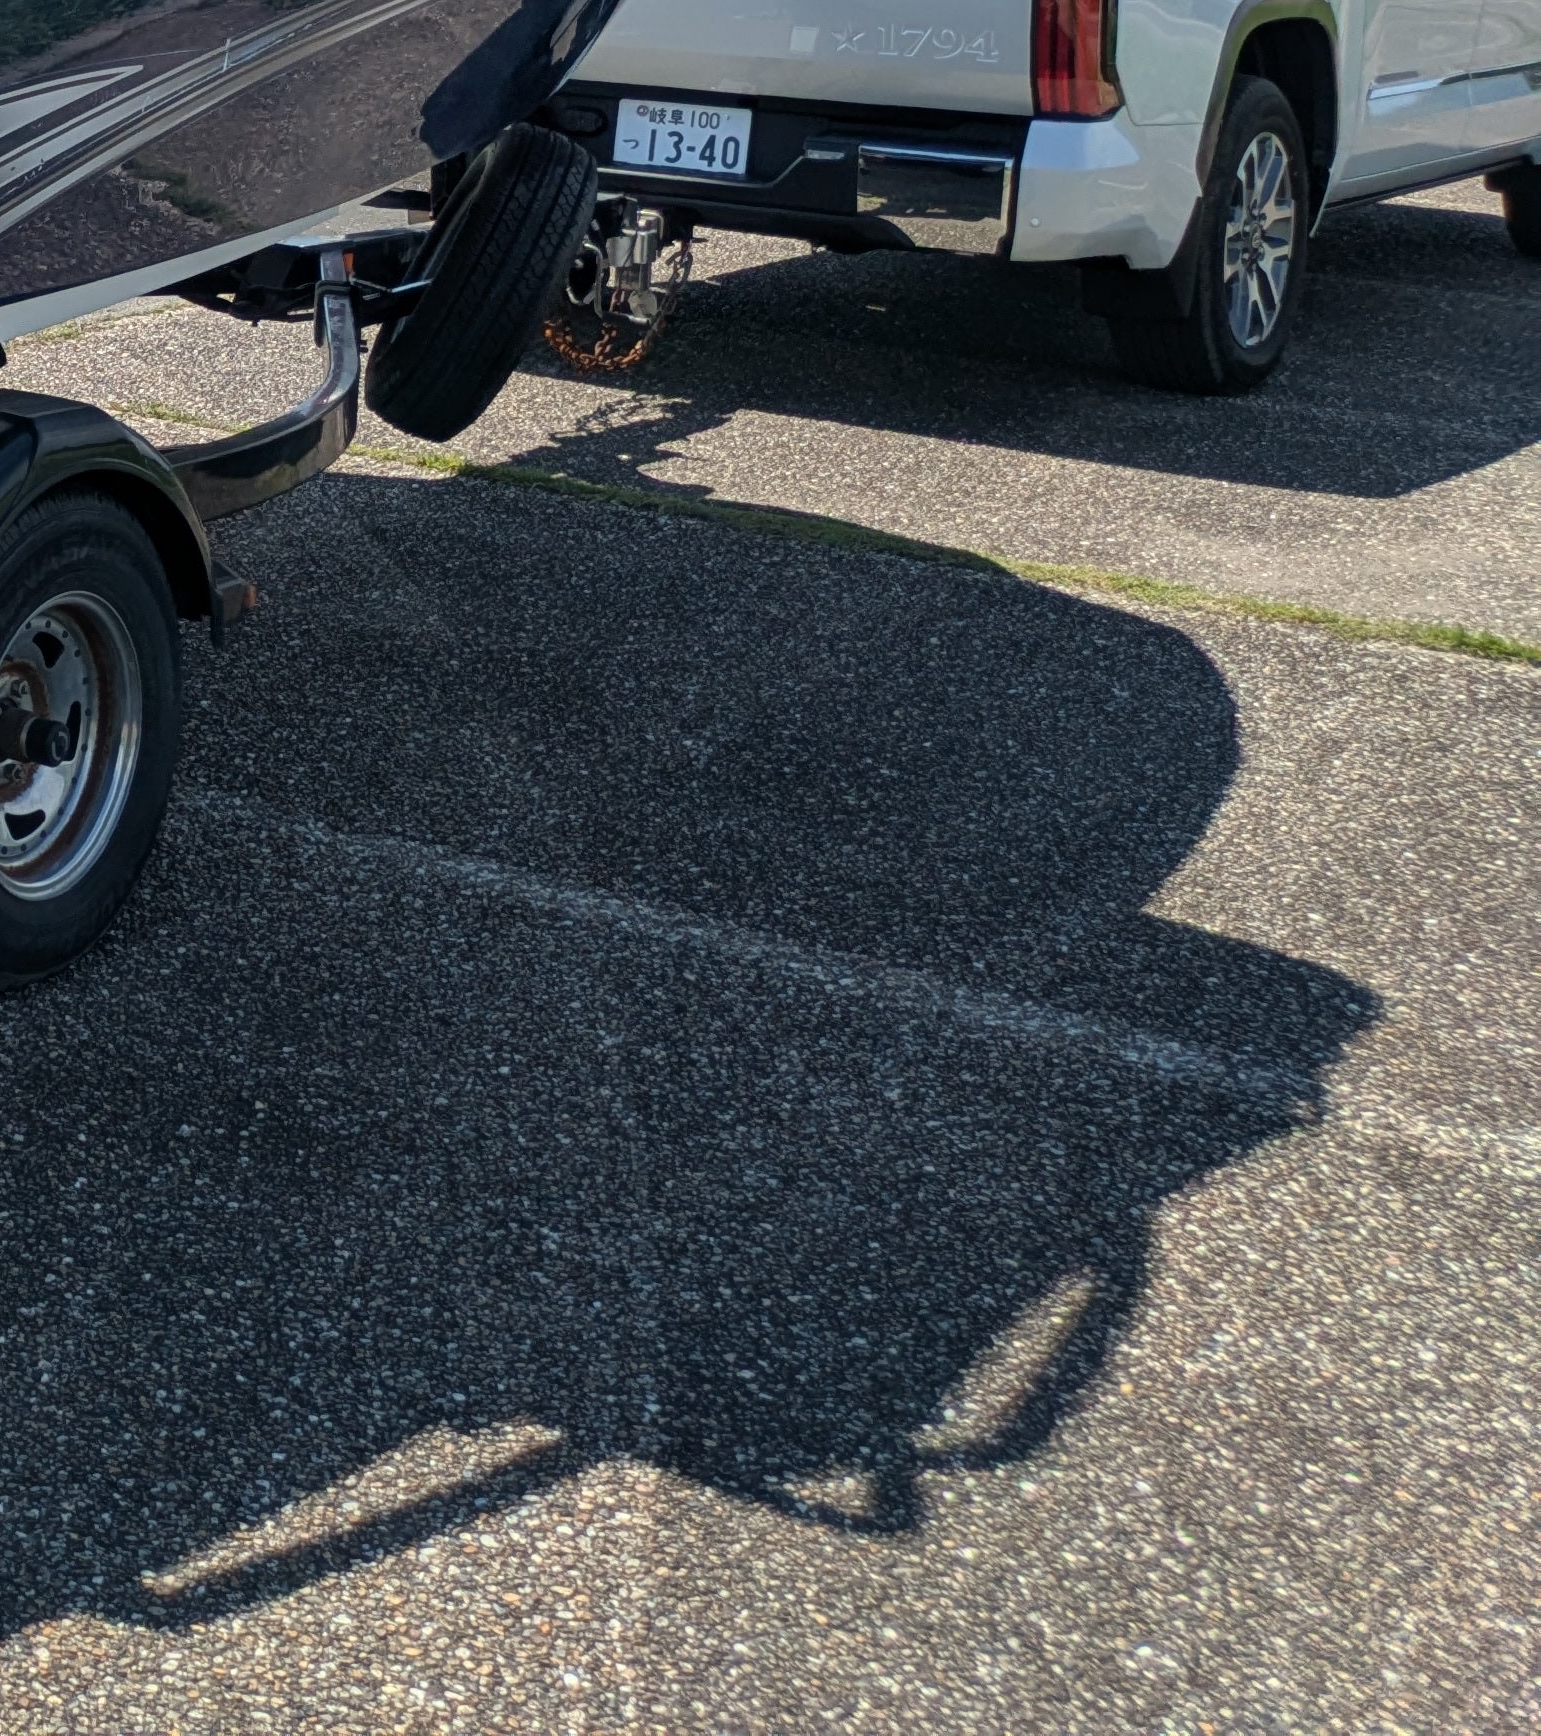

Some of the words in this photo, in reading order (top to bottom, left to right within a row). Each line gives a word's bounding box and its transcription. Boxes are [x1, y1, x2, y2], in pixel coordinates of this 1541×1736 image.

[876, 21, 1000, 63] 1794
[648, 107, 685, 125] 岐阜
[690, 109, 721, 130] 100
[621, 138, 640, 150] つ
[647, 128, 741, 170] 13-40
